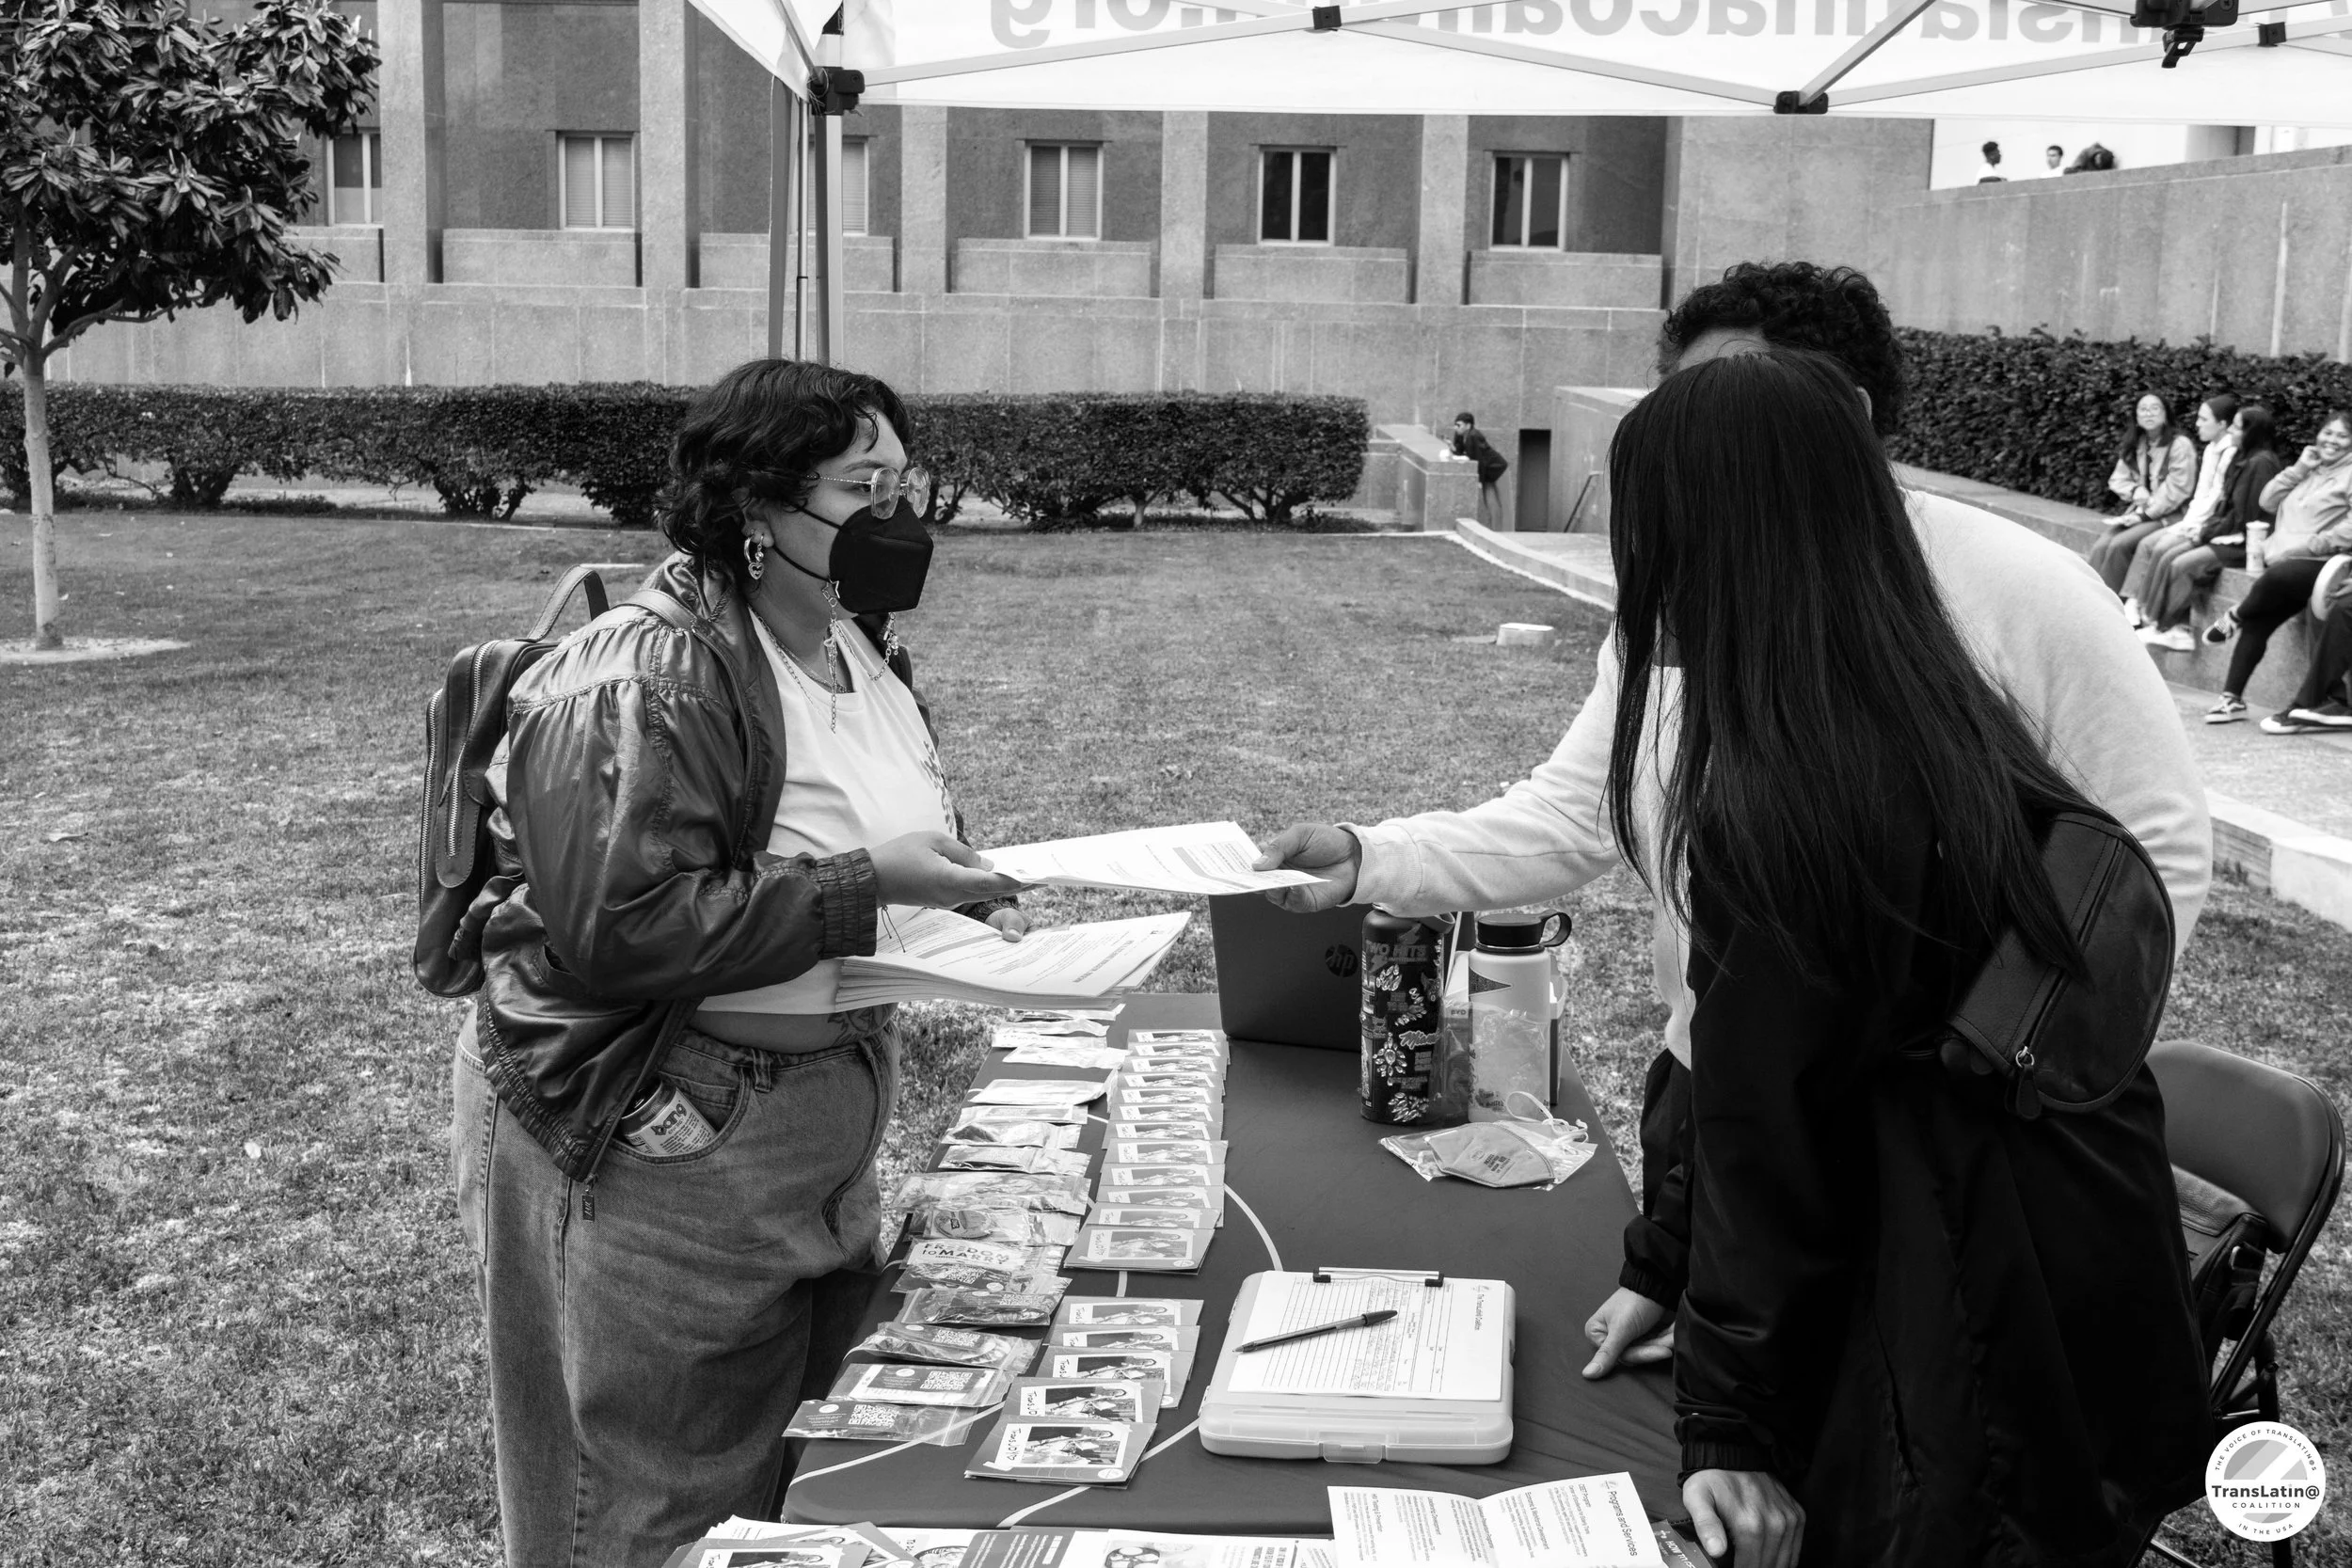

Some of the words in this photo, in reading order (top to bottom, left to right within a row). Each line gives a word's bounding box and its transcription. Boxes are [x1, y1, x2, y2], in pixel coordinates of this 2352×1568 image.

[1327, 943, 1357, 976] hp
[1393, 944, 1427, 958] HITS
[651, 1103, 687, 1135] bang
[924, 1243, 1009, 1260] FREEDOM
[1581, 1493, 1592, 1507] Program
[1608, 1491, 1624, 1517] Programs
[1618, 1516, 1628, 1528] and
[1536, 1526, 1549, 1550] Development
[1622, 1527, 1638, 1557] Services
[1665, 1541, 1682, 1554] HOW
